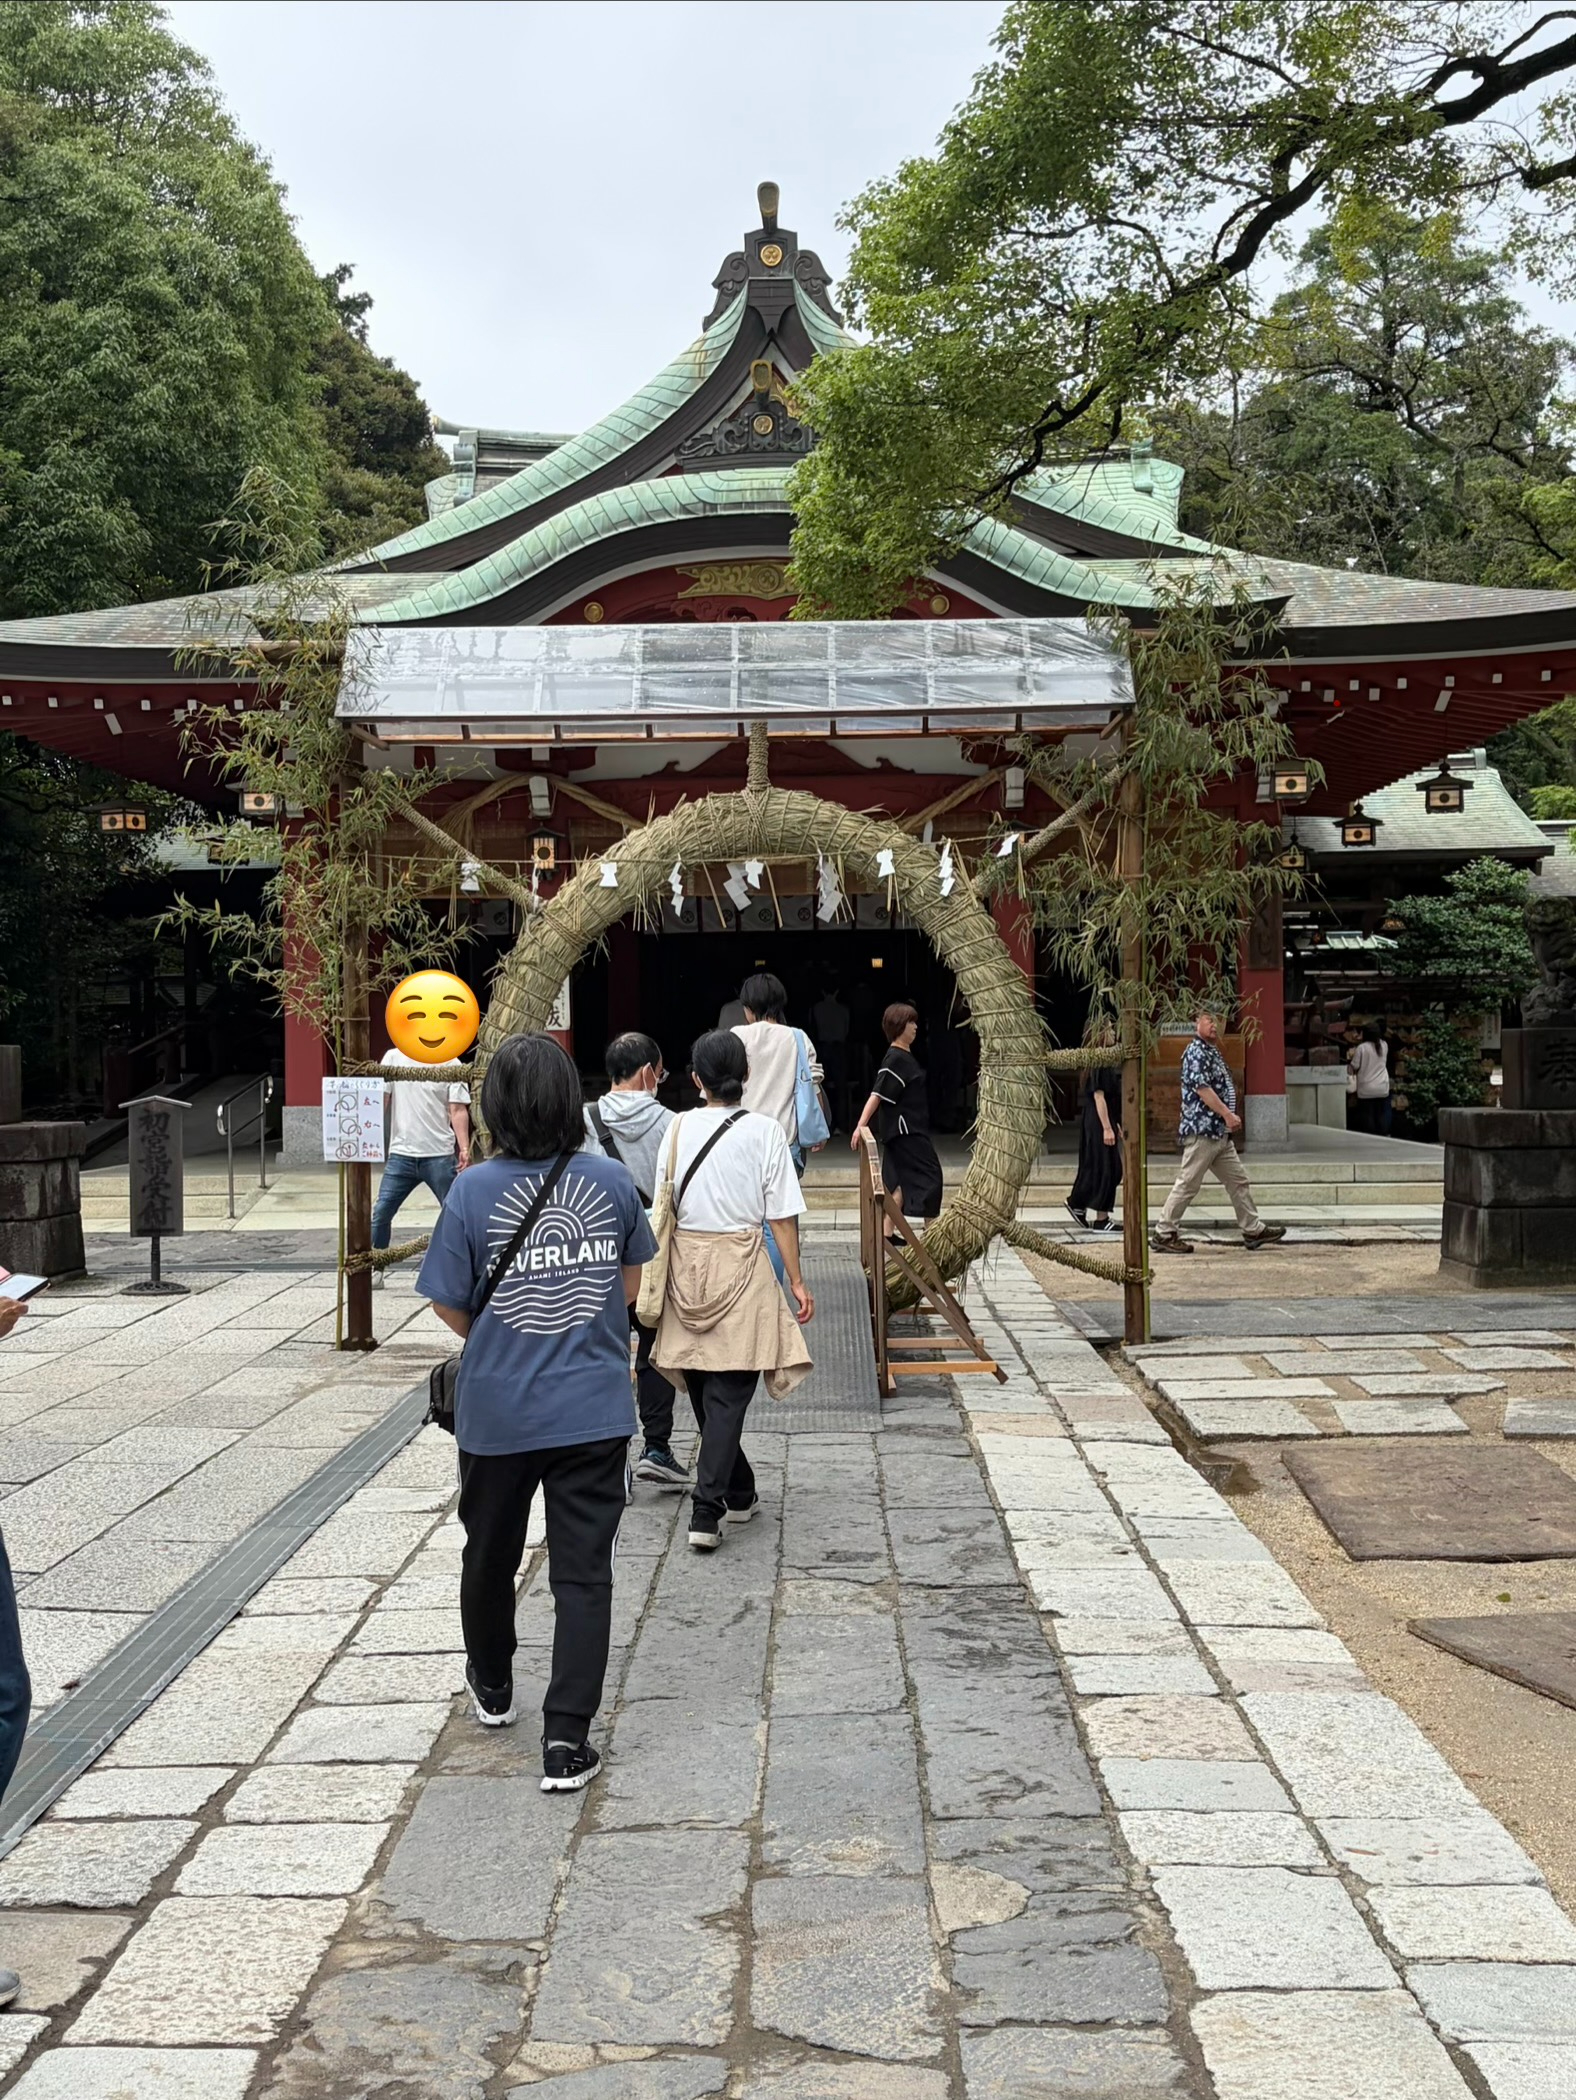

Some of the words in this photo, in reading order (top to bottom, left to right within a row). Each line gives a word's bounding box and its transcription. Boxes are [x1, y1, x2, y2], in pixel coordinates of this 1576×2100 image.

[138, 1110, 173, 1227] 初宮詣受付
